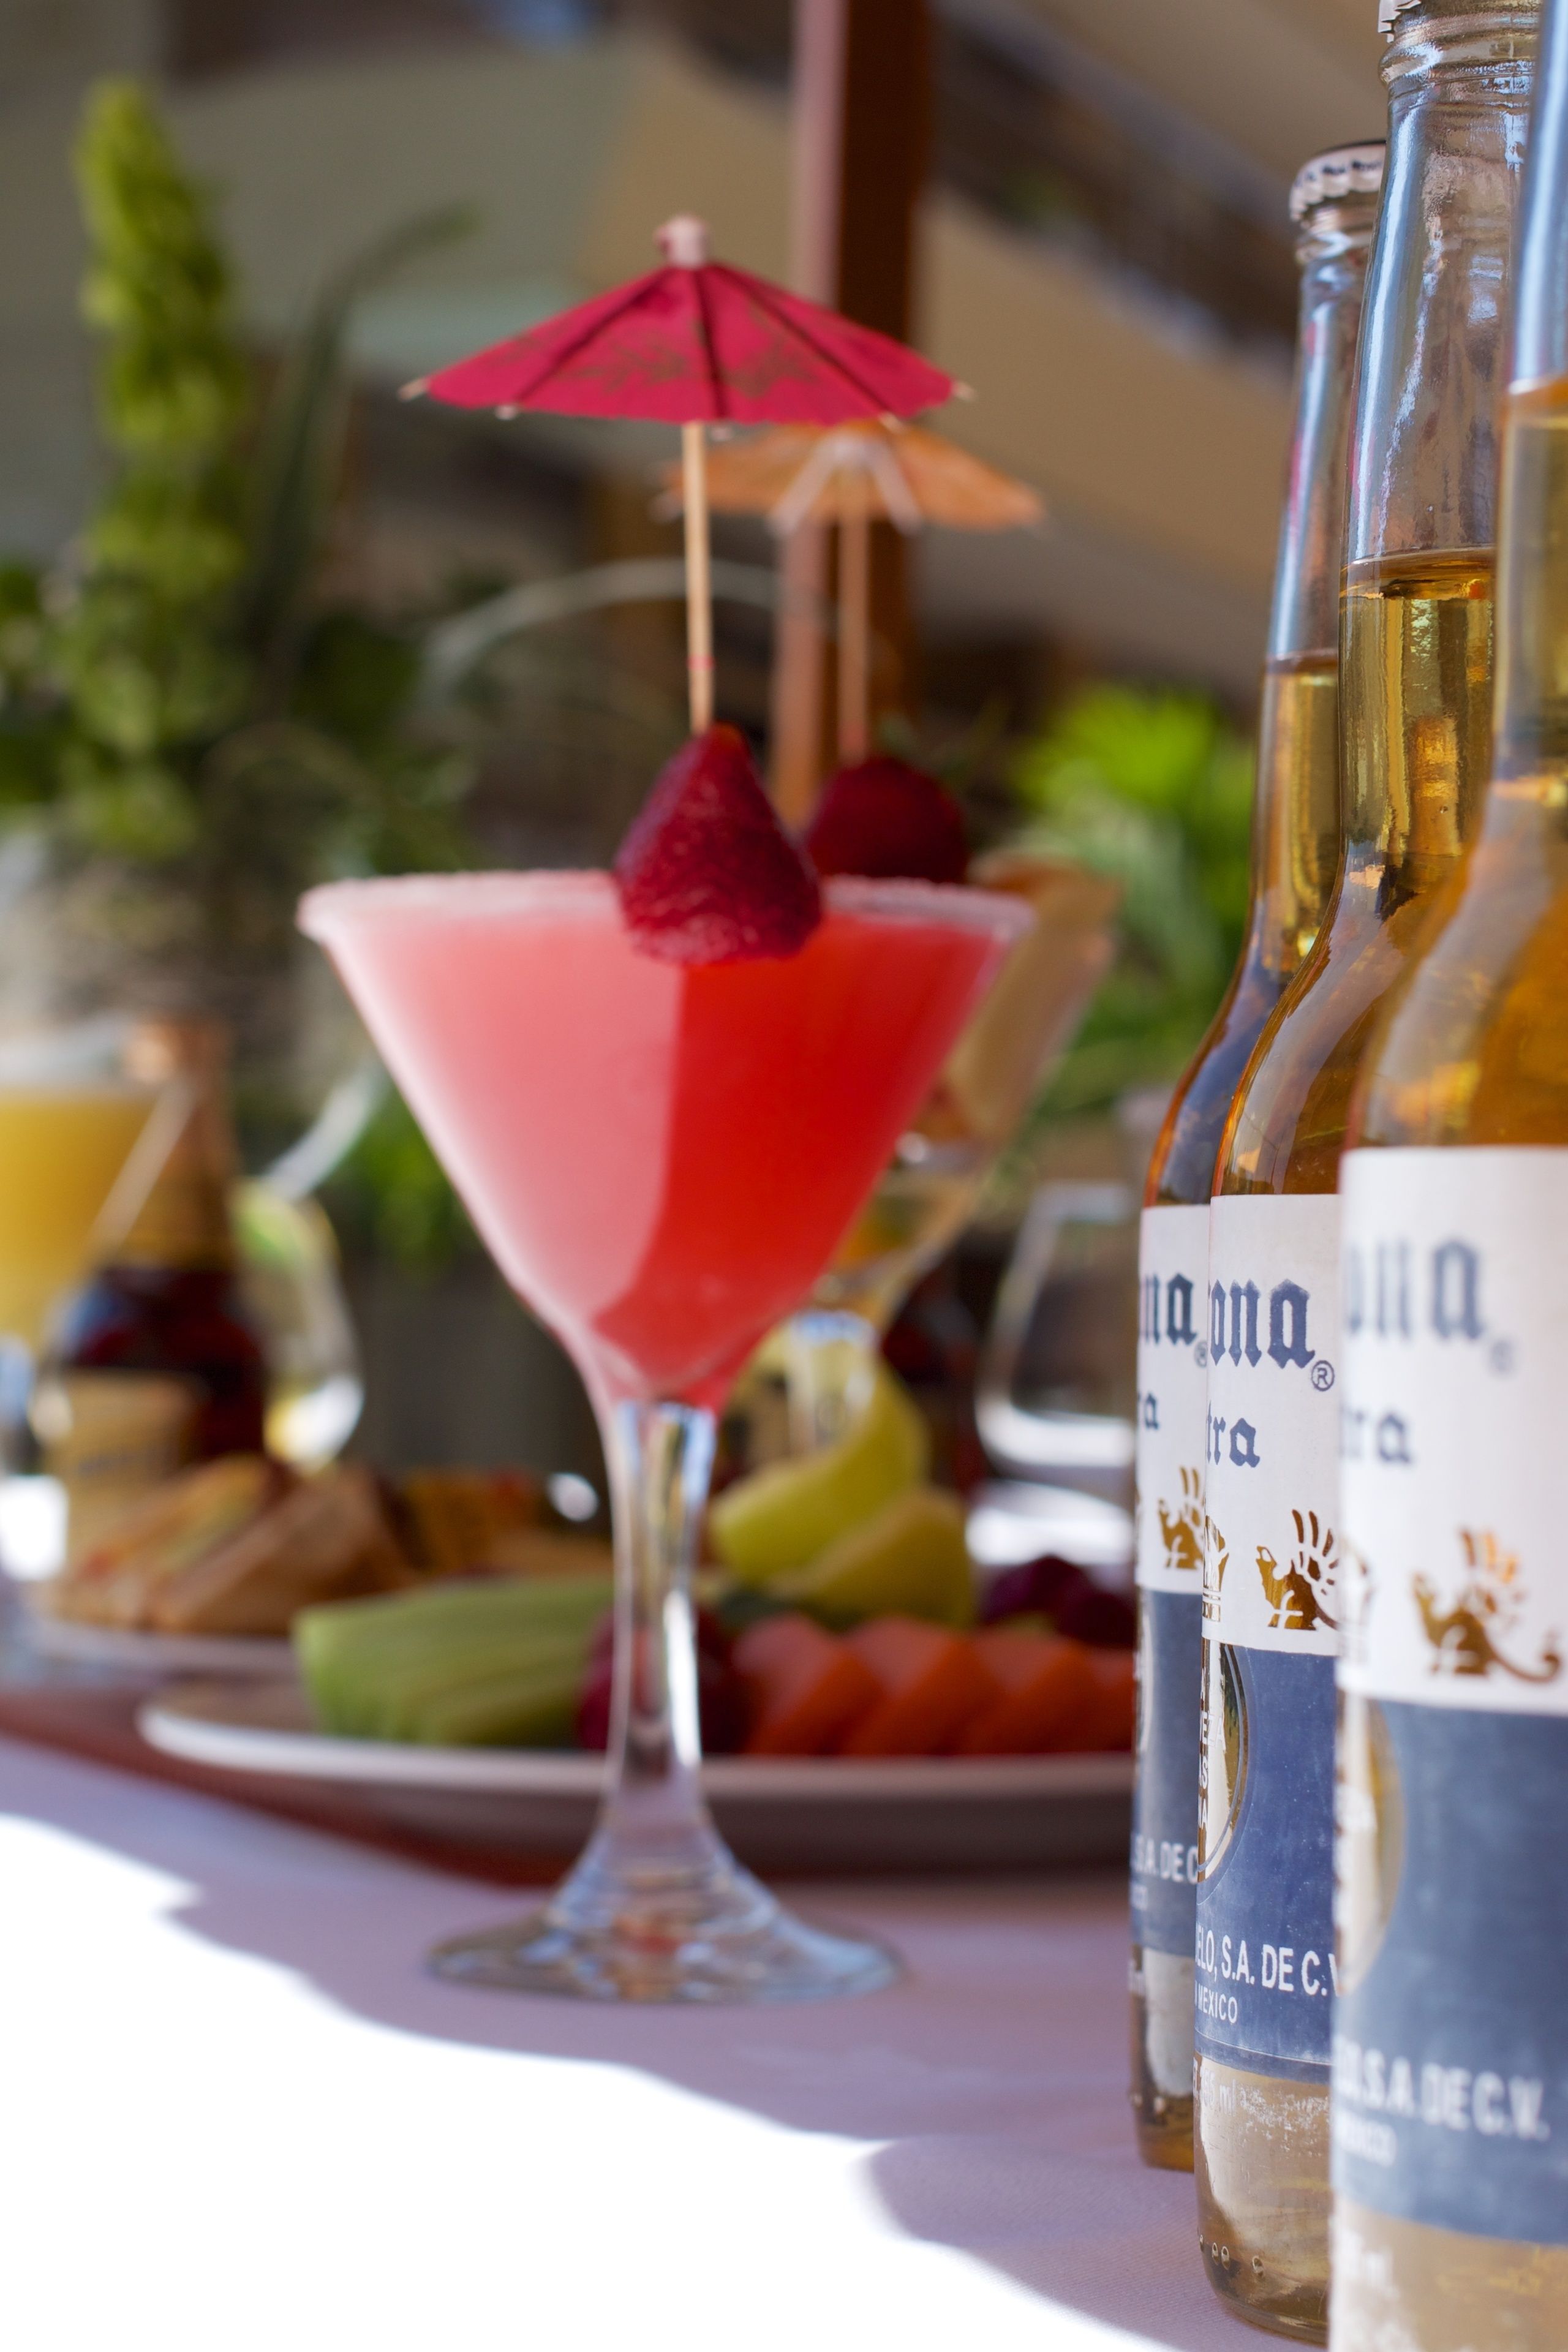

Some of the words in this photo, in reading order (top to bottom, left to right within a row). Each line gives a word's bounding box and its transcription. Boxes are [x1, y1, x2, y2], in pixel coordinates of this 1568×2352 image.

[1208, 1278, 1316, 1369] ona
[1196, 1921, 1218, 1983] ELO,
[1221, 1934, 1256, 1985] S.A.
[1262, 1944, 1294, 1992] DE
[1198, 1982, 1238, 2024] MEXICO
